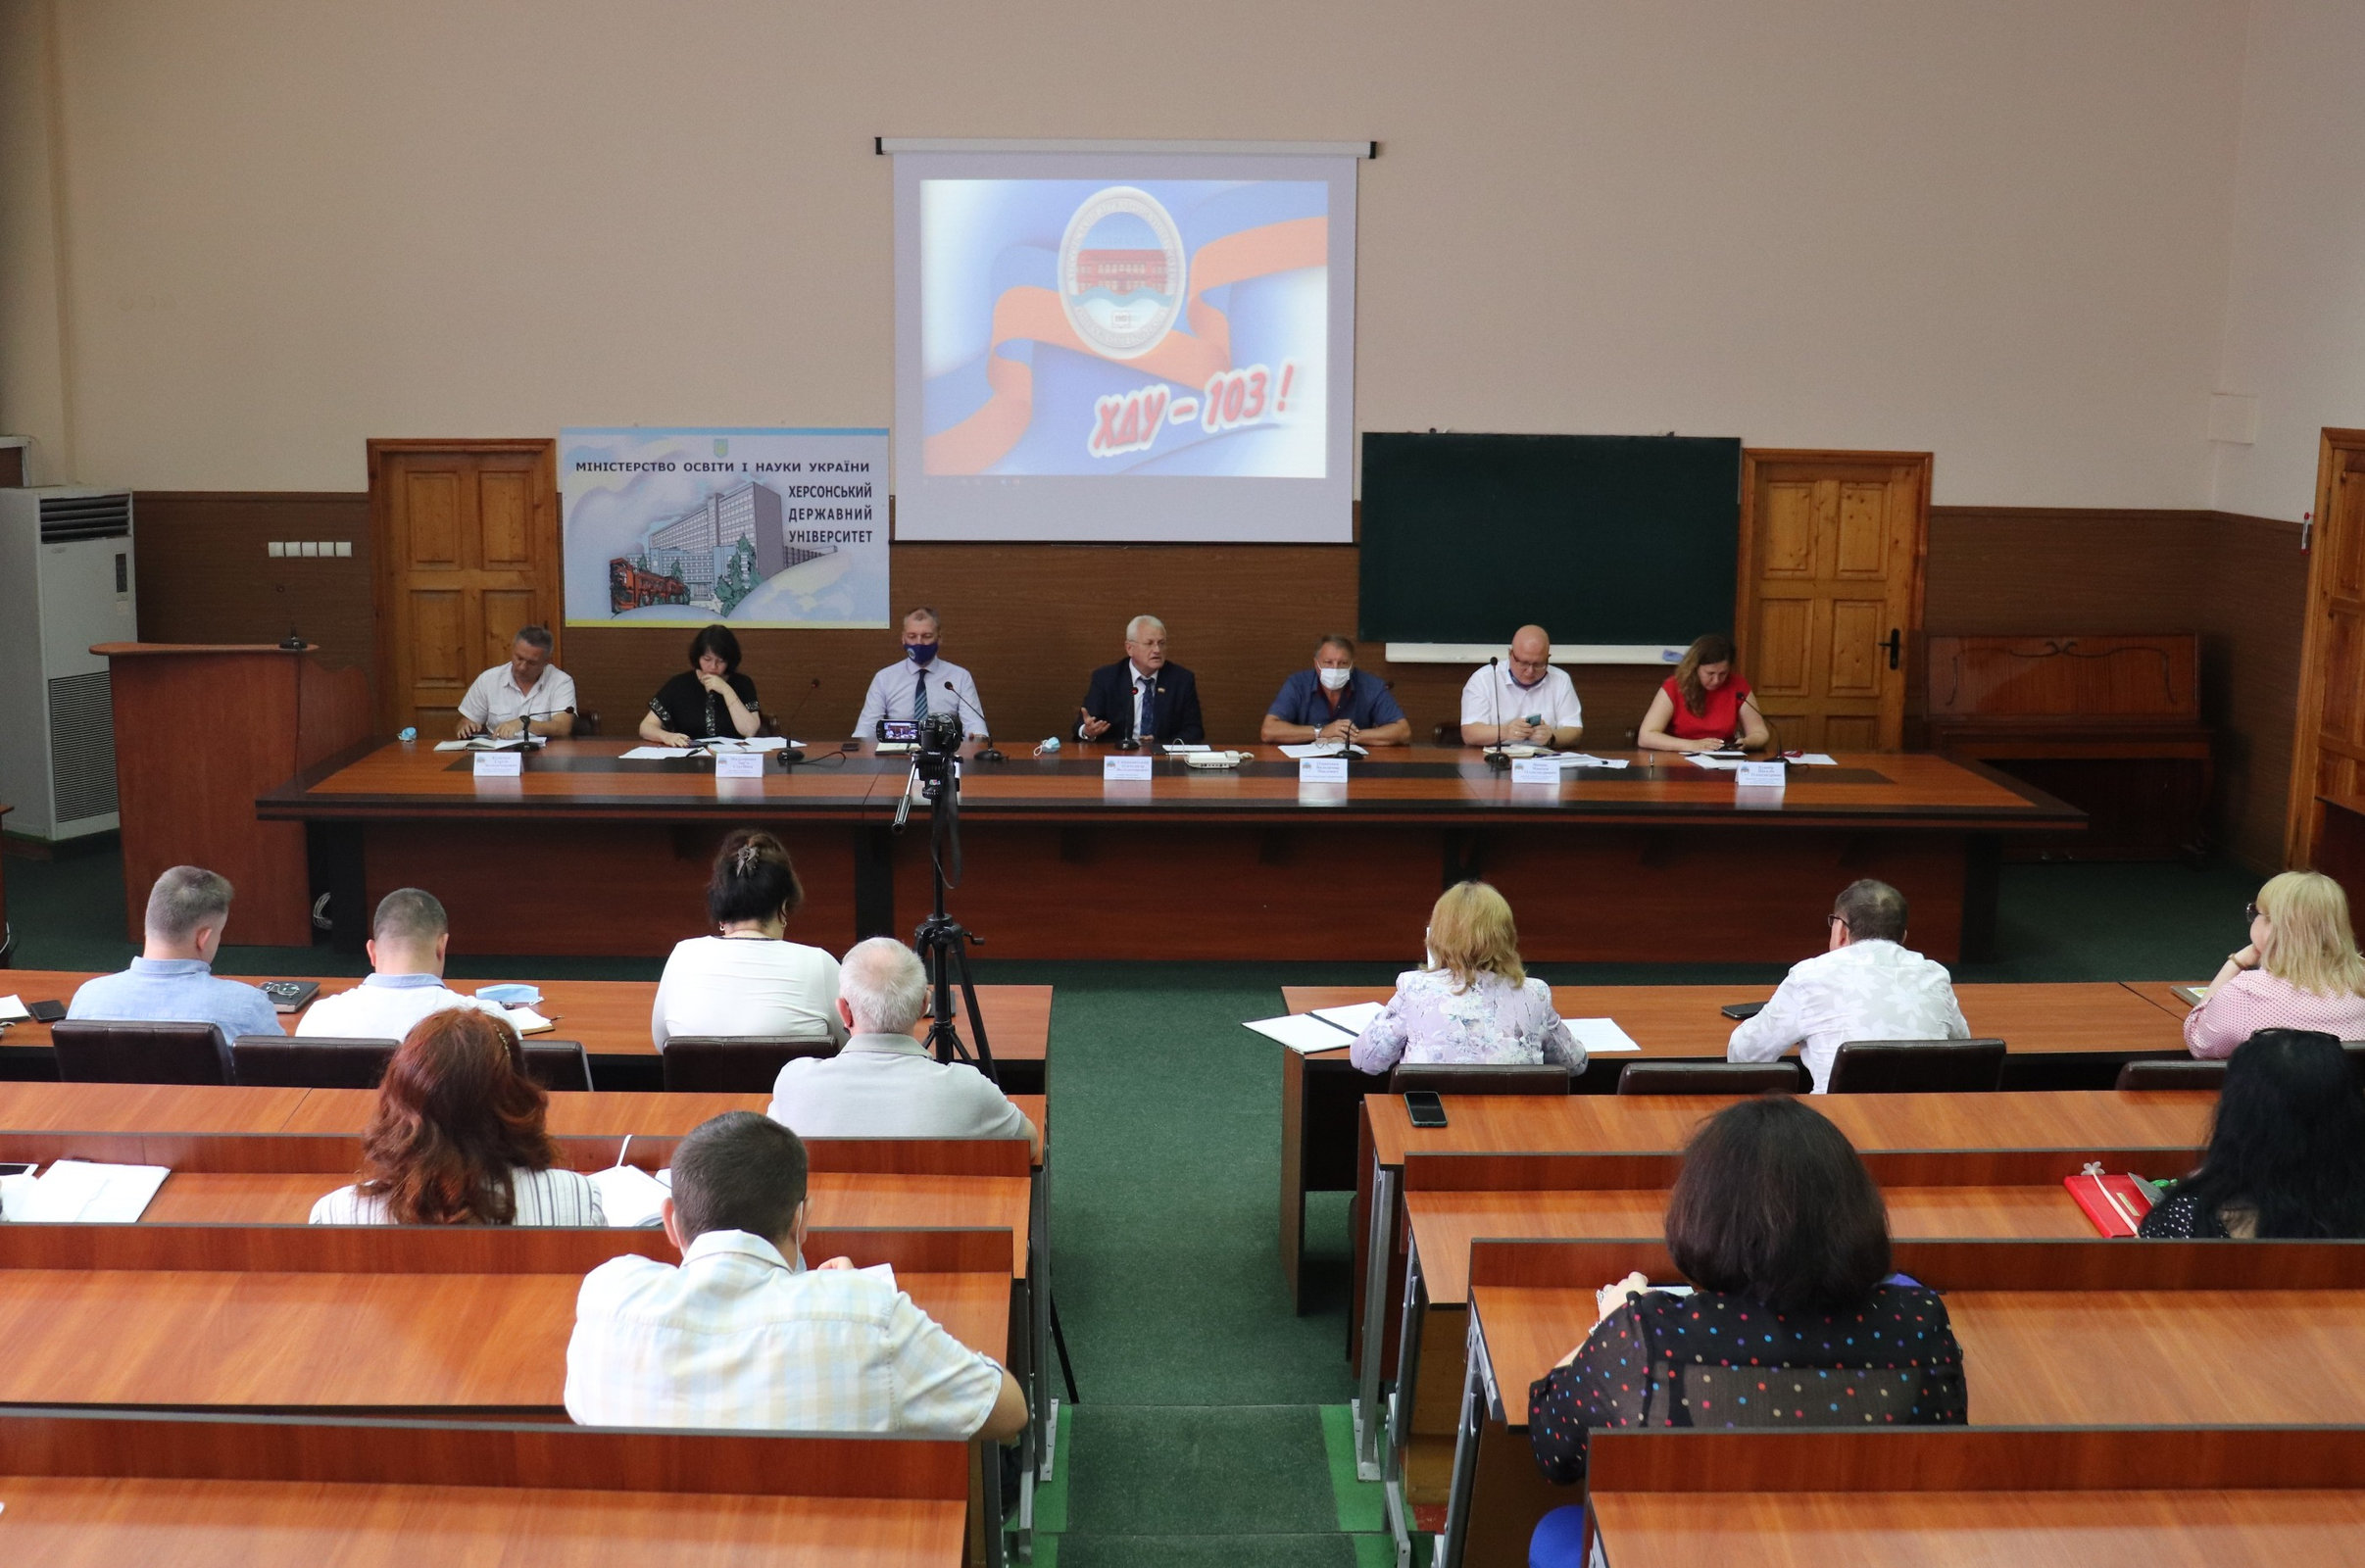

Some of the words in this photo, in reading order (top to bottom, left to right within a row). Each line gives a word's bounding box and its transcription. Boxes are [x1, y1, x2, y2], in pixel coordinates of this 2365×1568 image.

[1094, 392, 1166, 449] ХДУ
[575, 462, 676, 472] МІНІСТЕРСТВО
[683, 462, 735, 472] ОСВІТИ
[741, 462, 748, 472] І
[755, 462, 802, 472] НАУКИ
[809, 460, 870, 473] УКРАЇНИ
[788, 481, 872, 499] ХЕРСОНСЬКИЙ
[788, 505, 872, 522] ДЕРЖАВНИЙ
[788, 529, 873, 543] УНІВЕРСИТЕТ
